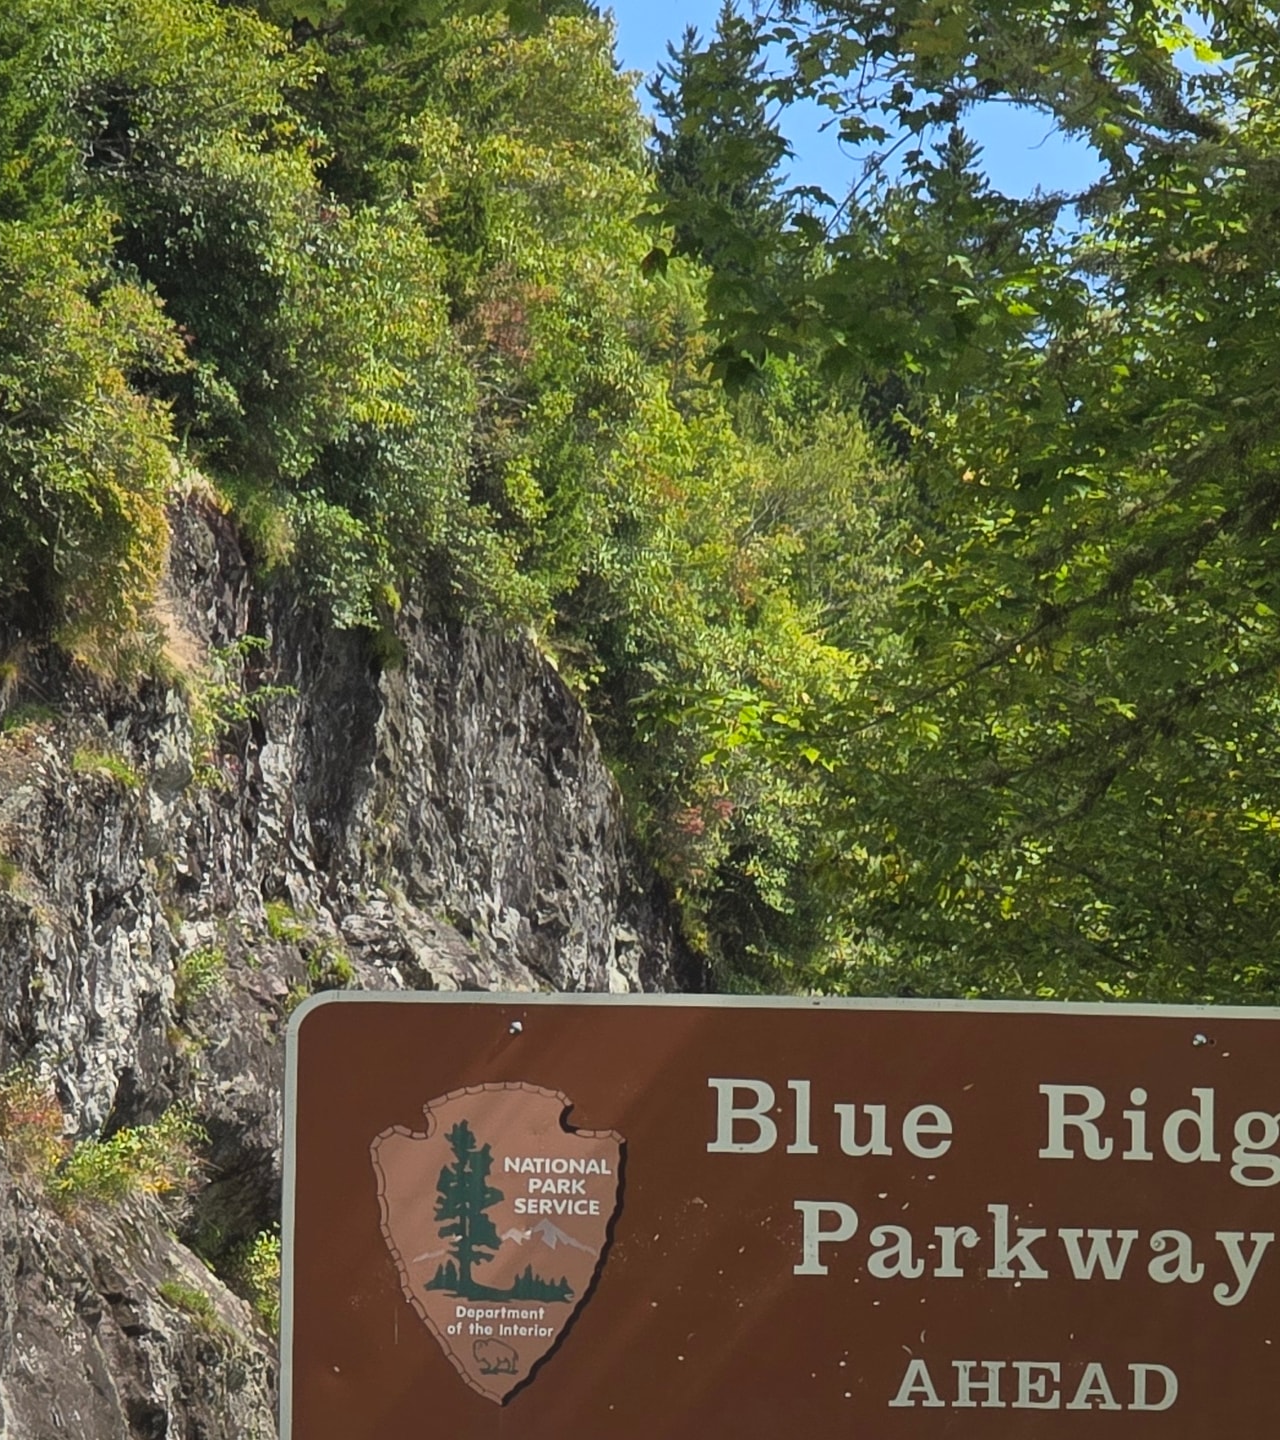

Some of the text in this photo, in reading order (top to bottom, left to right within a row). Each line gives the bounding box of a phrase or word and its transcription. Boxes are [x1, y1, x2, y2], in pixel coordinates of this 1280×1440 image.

[706, 1078, 955, 1159] Blue
[503, 1156, 612, 1175] NATIONAL
[527, 1178, 587, 1195] PARK
[513, 1198, 601, 1216] SERVICE
[792, 1200, 1275, 1307] Parkway
[455, 1305, 545, 1321] Department
[446, 1322, 554, 1338] of the Interior
[888, 1359, 1181, 1412] AHEAD
